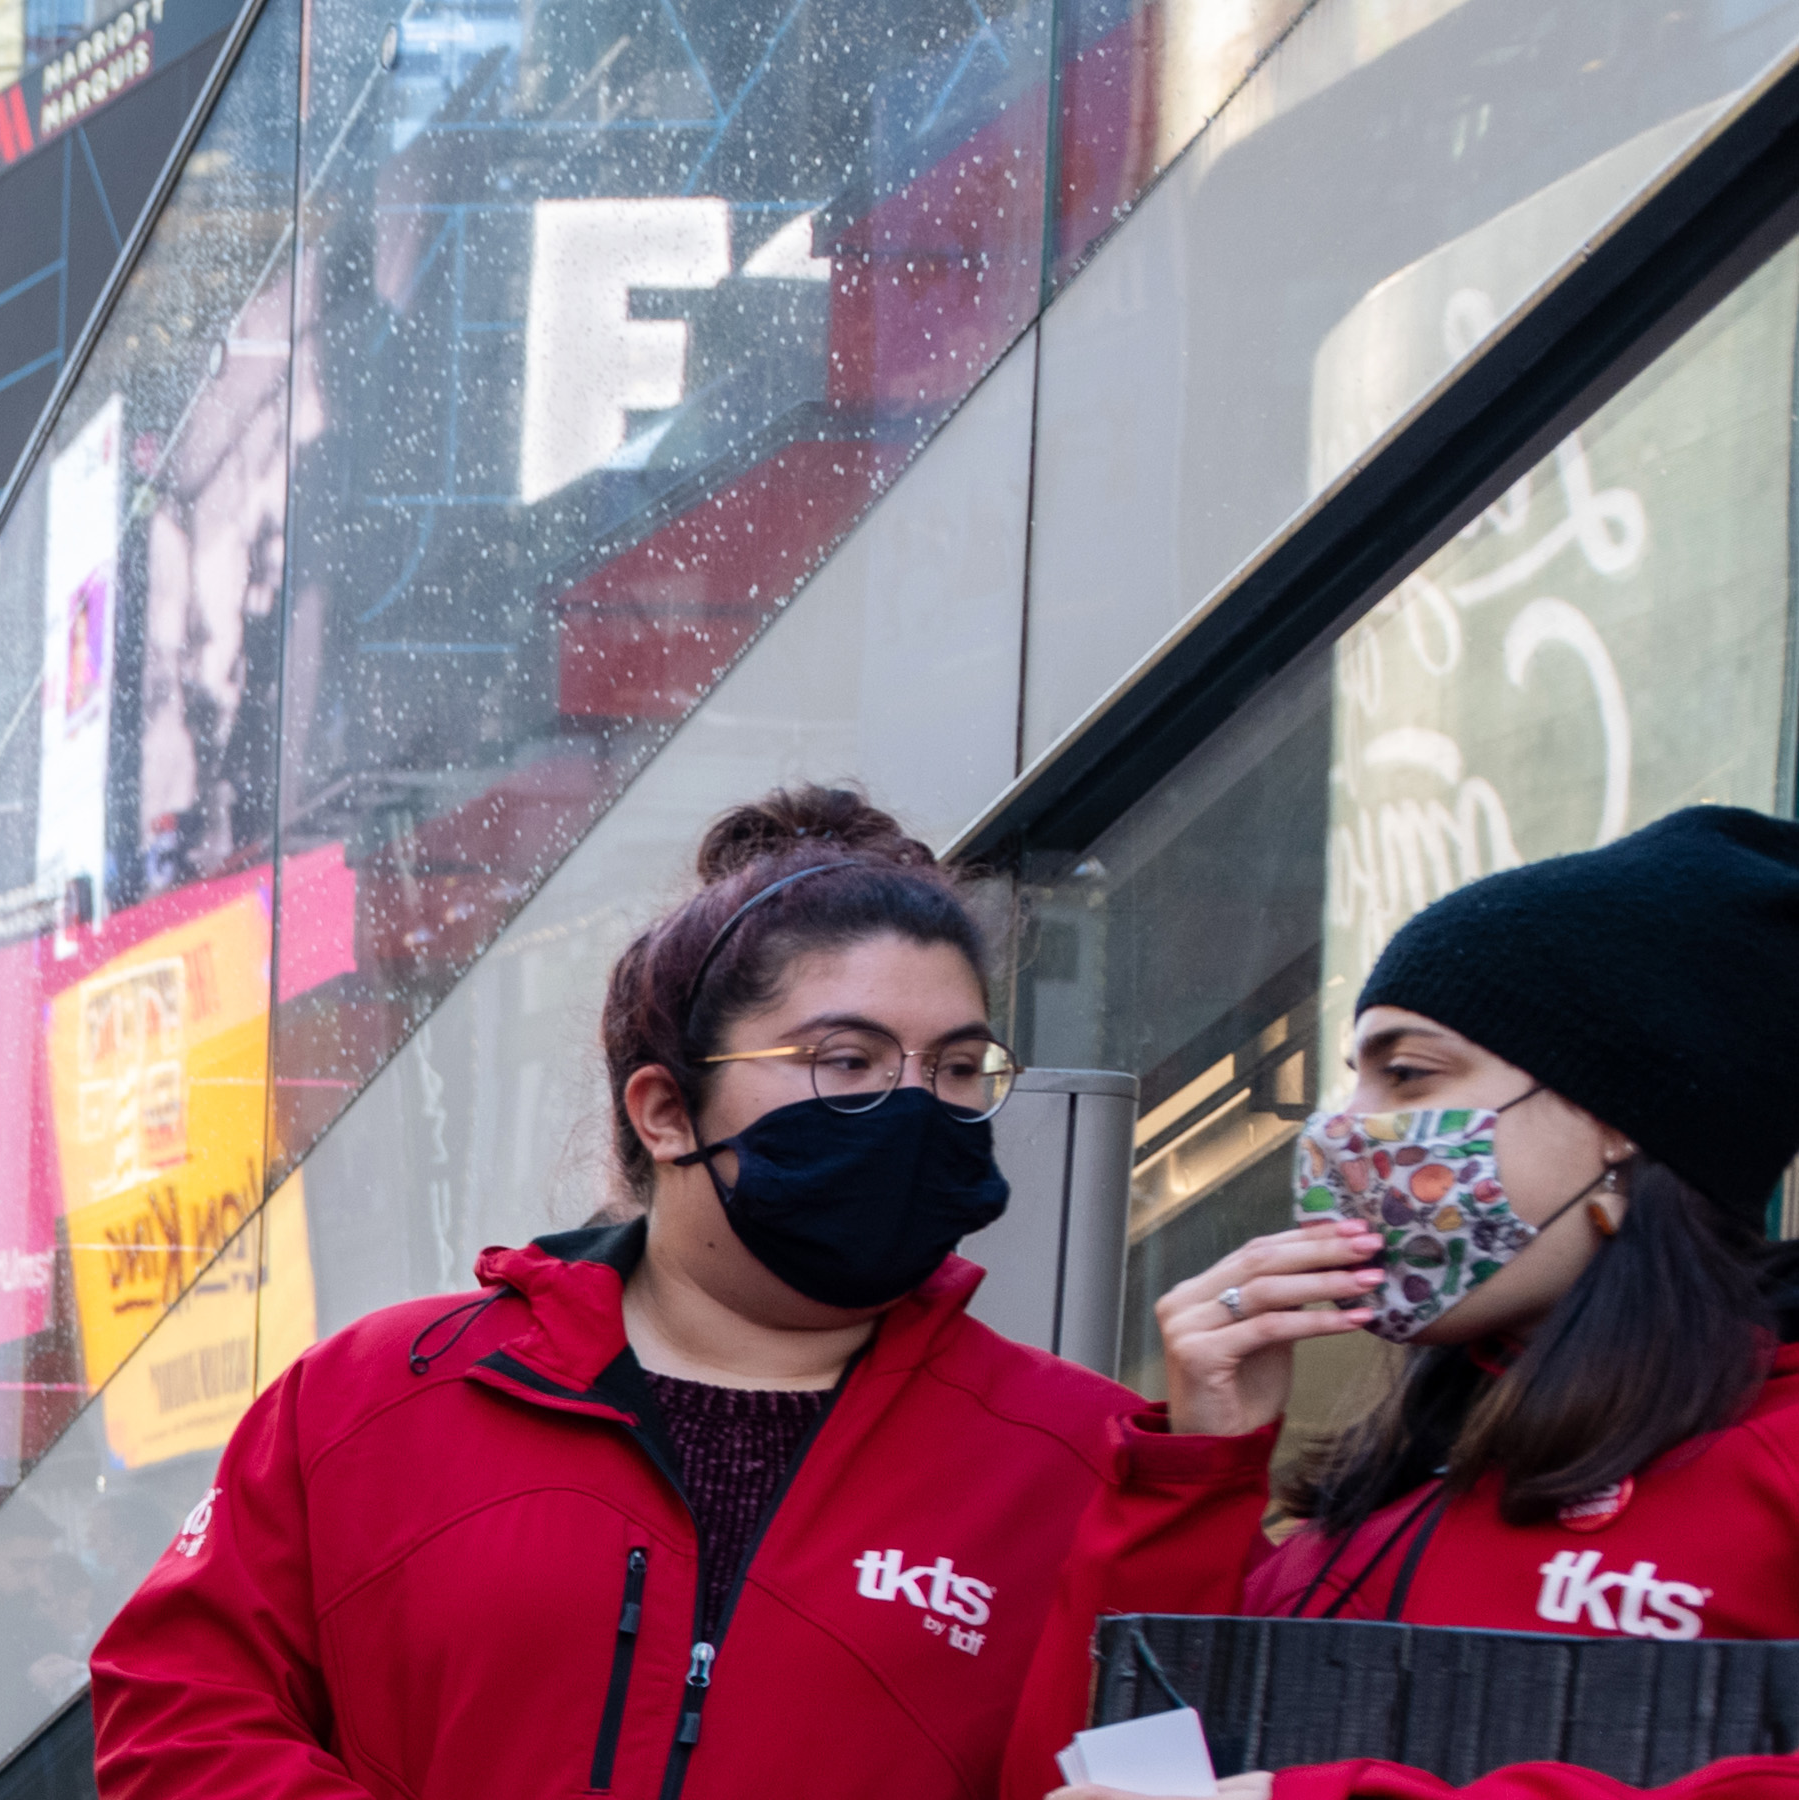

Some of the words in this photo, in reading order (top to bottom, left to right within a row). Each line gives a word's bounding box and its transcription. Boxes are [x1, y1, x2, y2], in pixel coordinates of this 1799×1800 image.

[41, 40, 150, 138] MARQUIS
[43, 0, 164, 97] MARRIOTT
[853, 1548, 991, 1627] tkts
[923, 1614, 948, 1636] by
[1535, 1549, 1705, 1641] tkts
[947, 1623, 987, 1657] tdf
